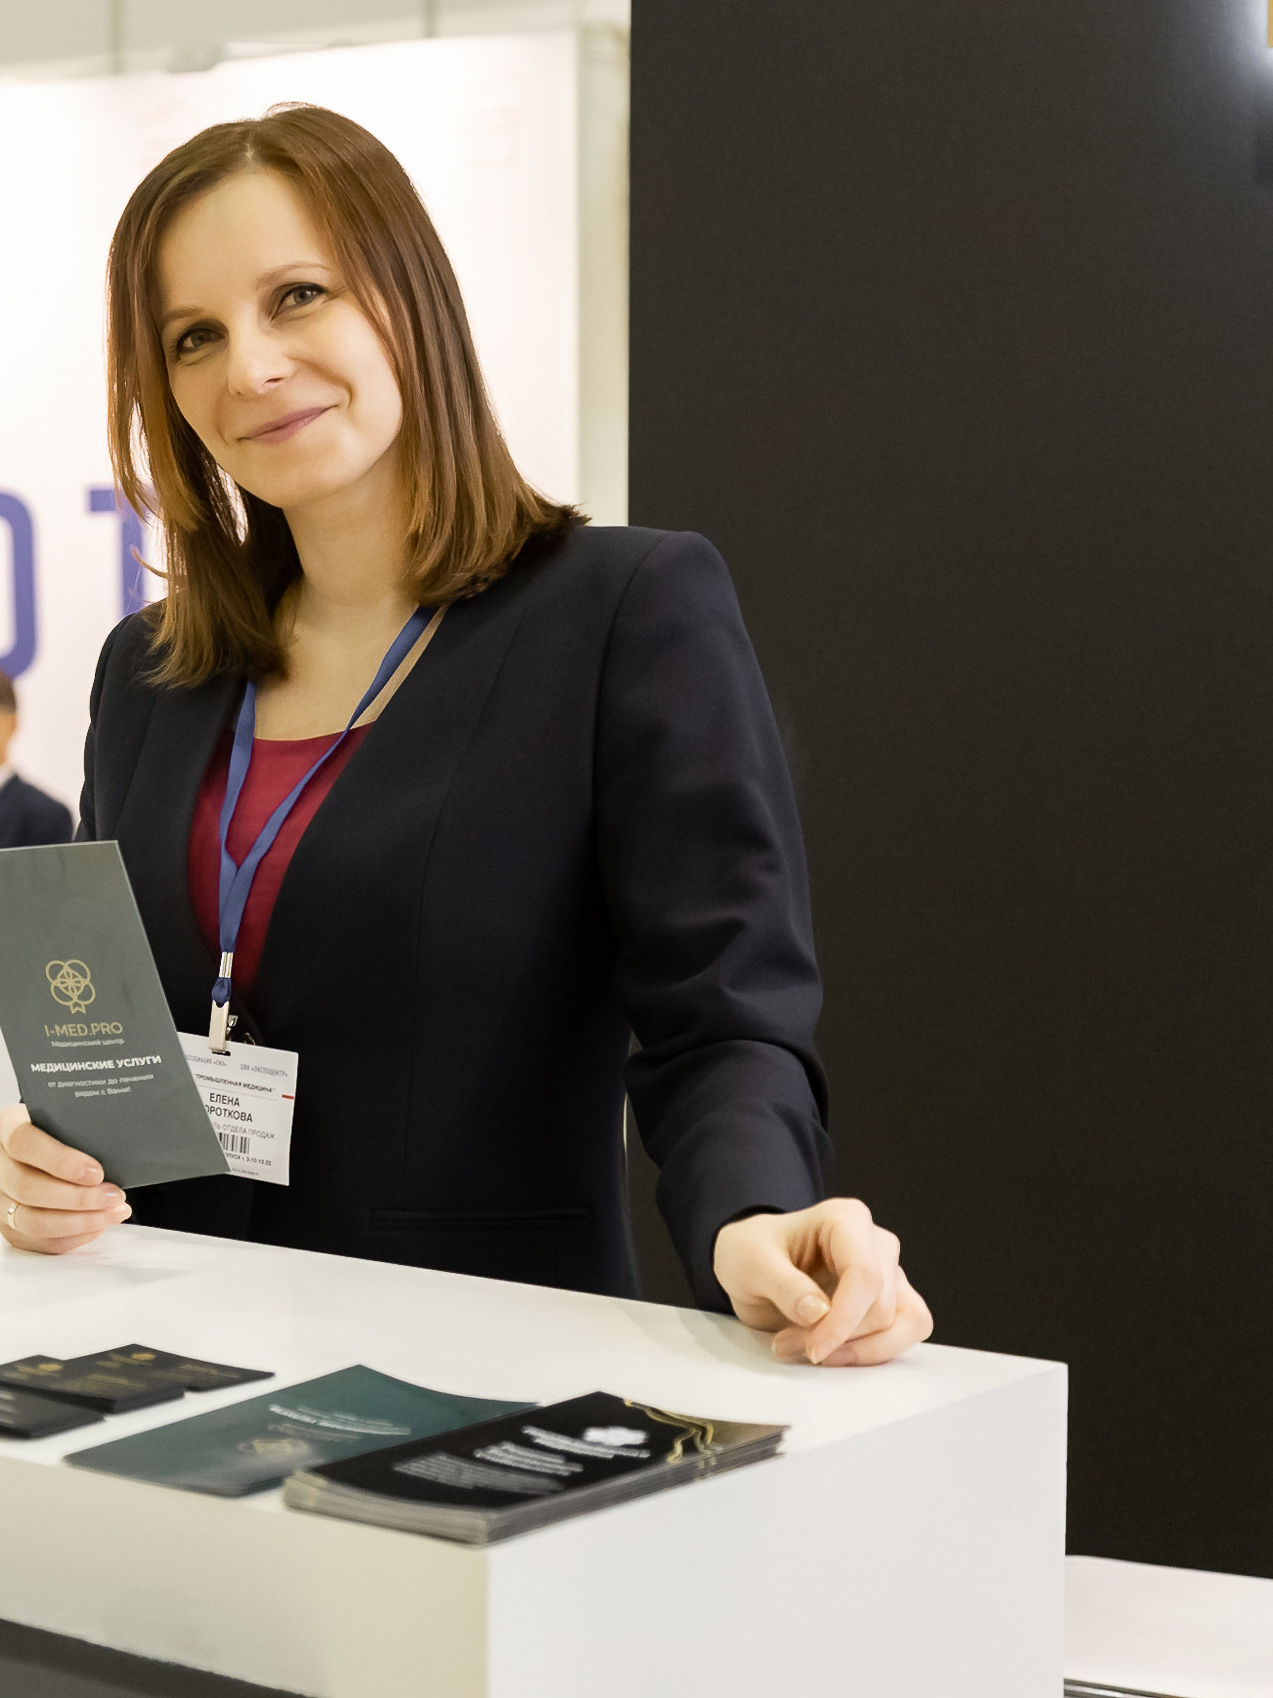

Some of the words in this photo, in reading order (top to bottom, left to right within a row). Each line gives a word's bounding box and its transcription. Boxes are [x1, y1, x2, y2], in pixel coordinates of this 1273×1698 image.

[44, 1022, 123, 1037] I-MED.PRO
[30, 1060, 115, 1073] МЕДИЦИНСКИЕ
[116, 1055, 162, 1069] УСЛУГИ
[209, 1092, 240, 1107] ЕЛЕНА
